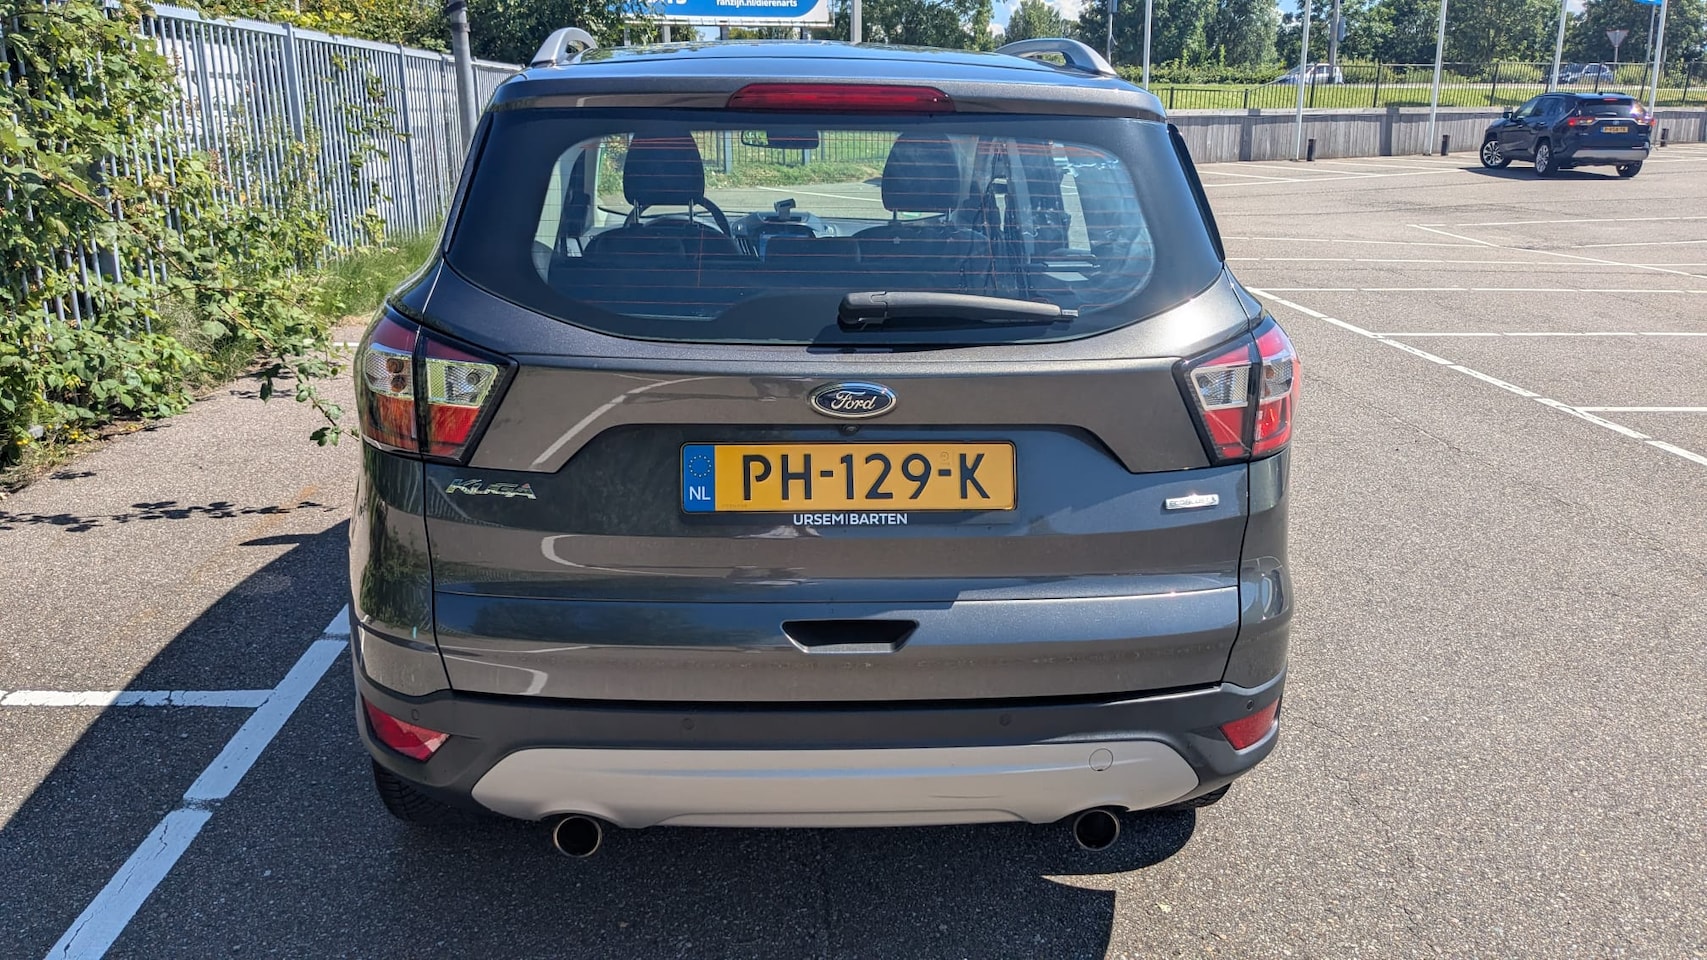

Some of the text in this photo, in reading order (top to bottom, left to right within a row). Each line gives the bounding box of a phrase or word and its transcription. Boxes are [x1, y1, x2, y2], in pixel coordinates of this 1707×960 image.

[831, 391, 877, 409] Ford
[689, 453, 990, 501] NL PH-129-K
[446, 479, 537, 500] KUGA
